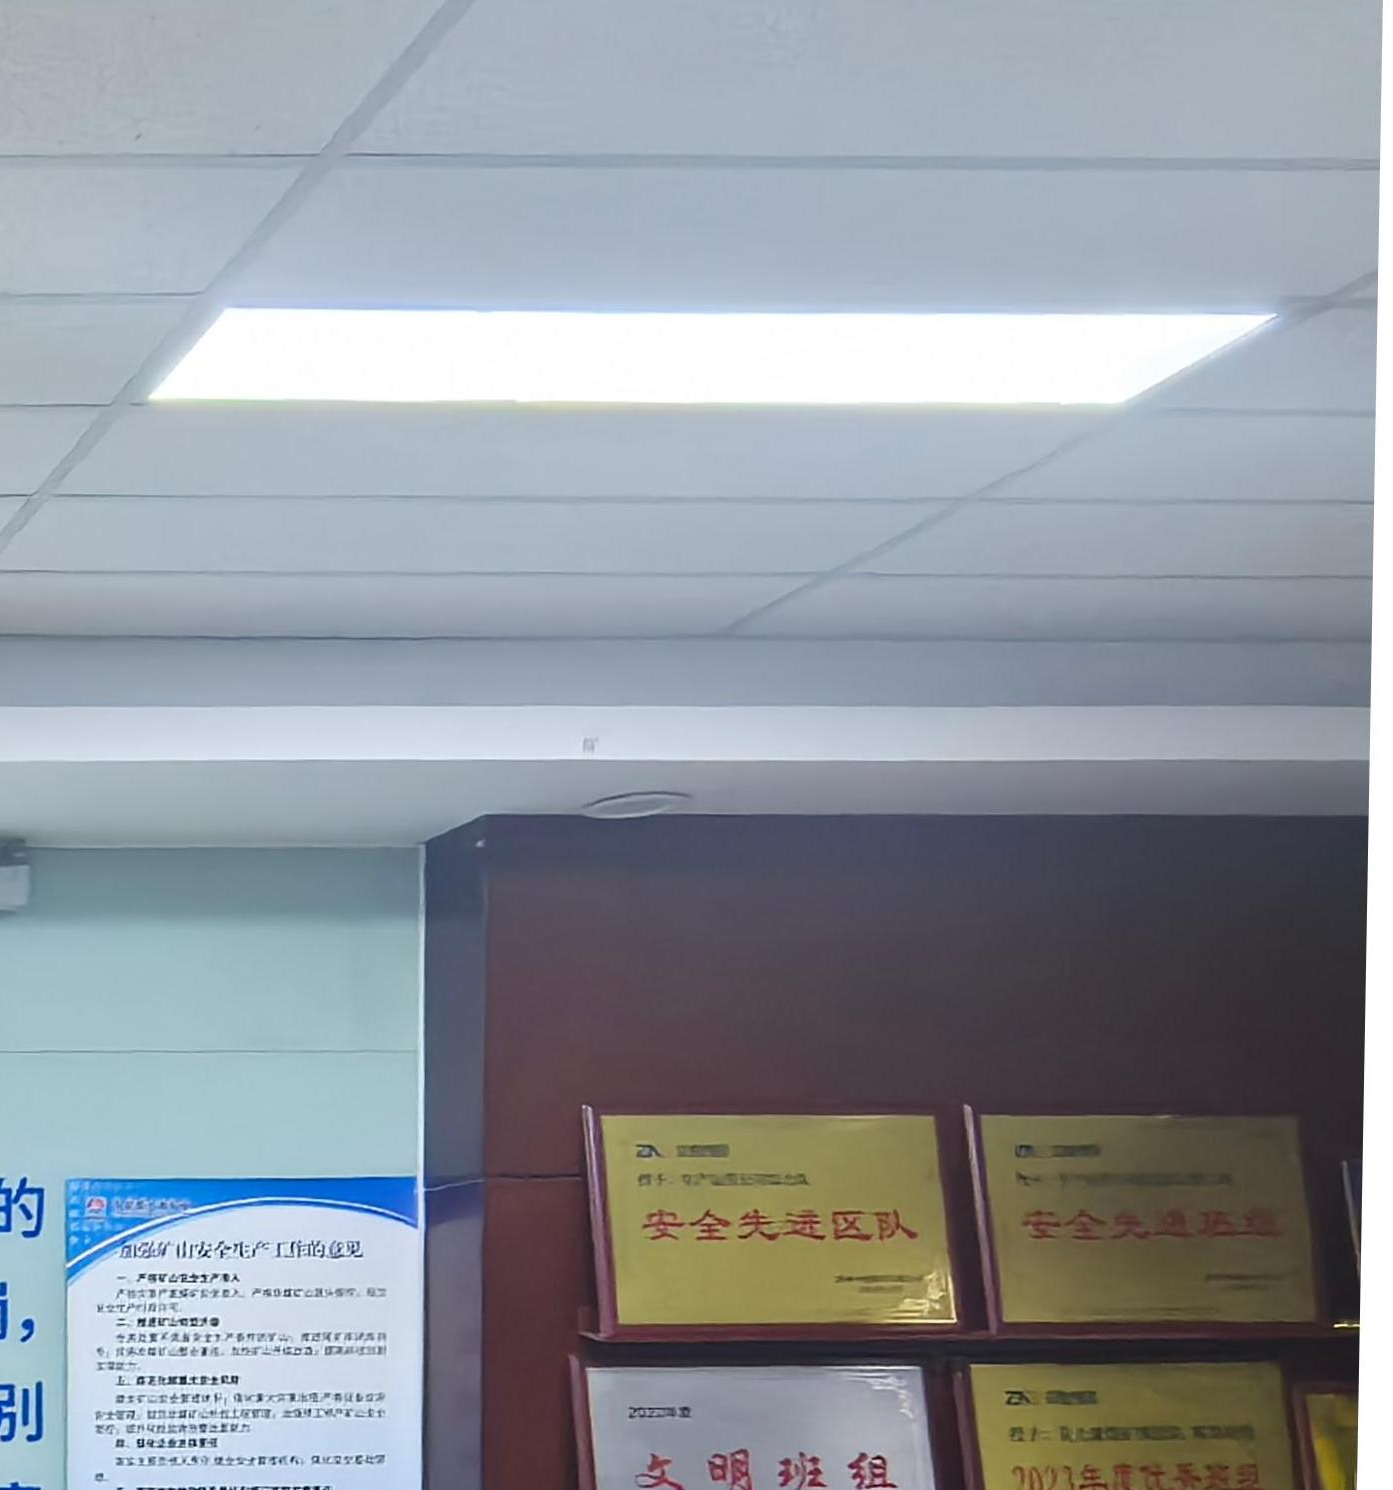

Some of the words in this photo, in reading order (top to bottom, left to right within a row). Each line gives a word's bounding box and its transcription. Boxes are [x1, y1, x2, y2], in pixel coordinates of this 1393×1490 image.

[641, 1209, 918, 1241] 安全先进区队
